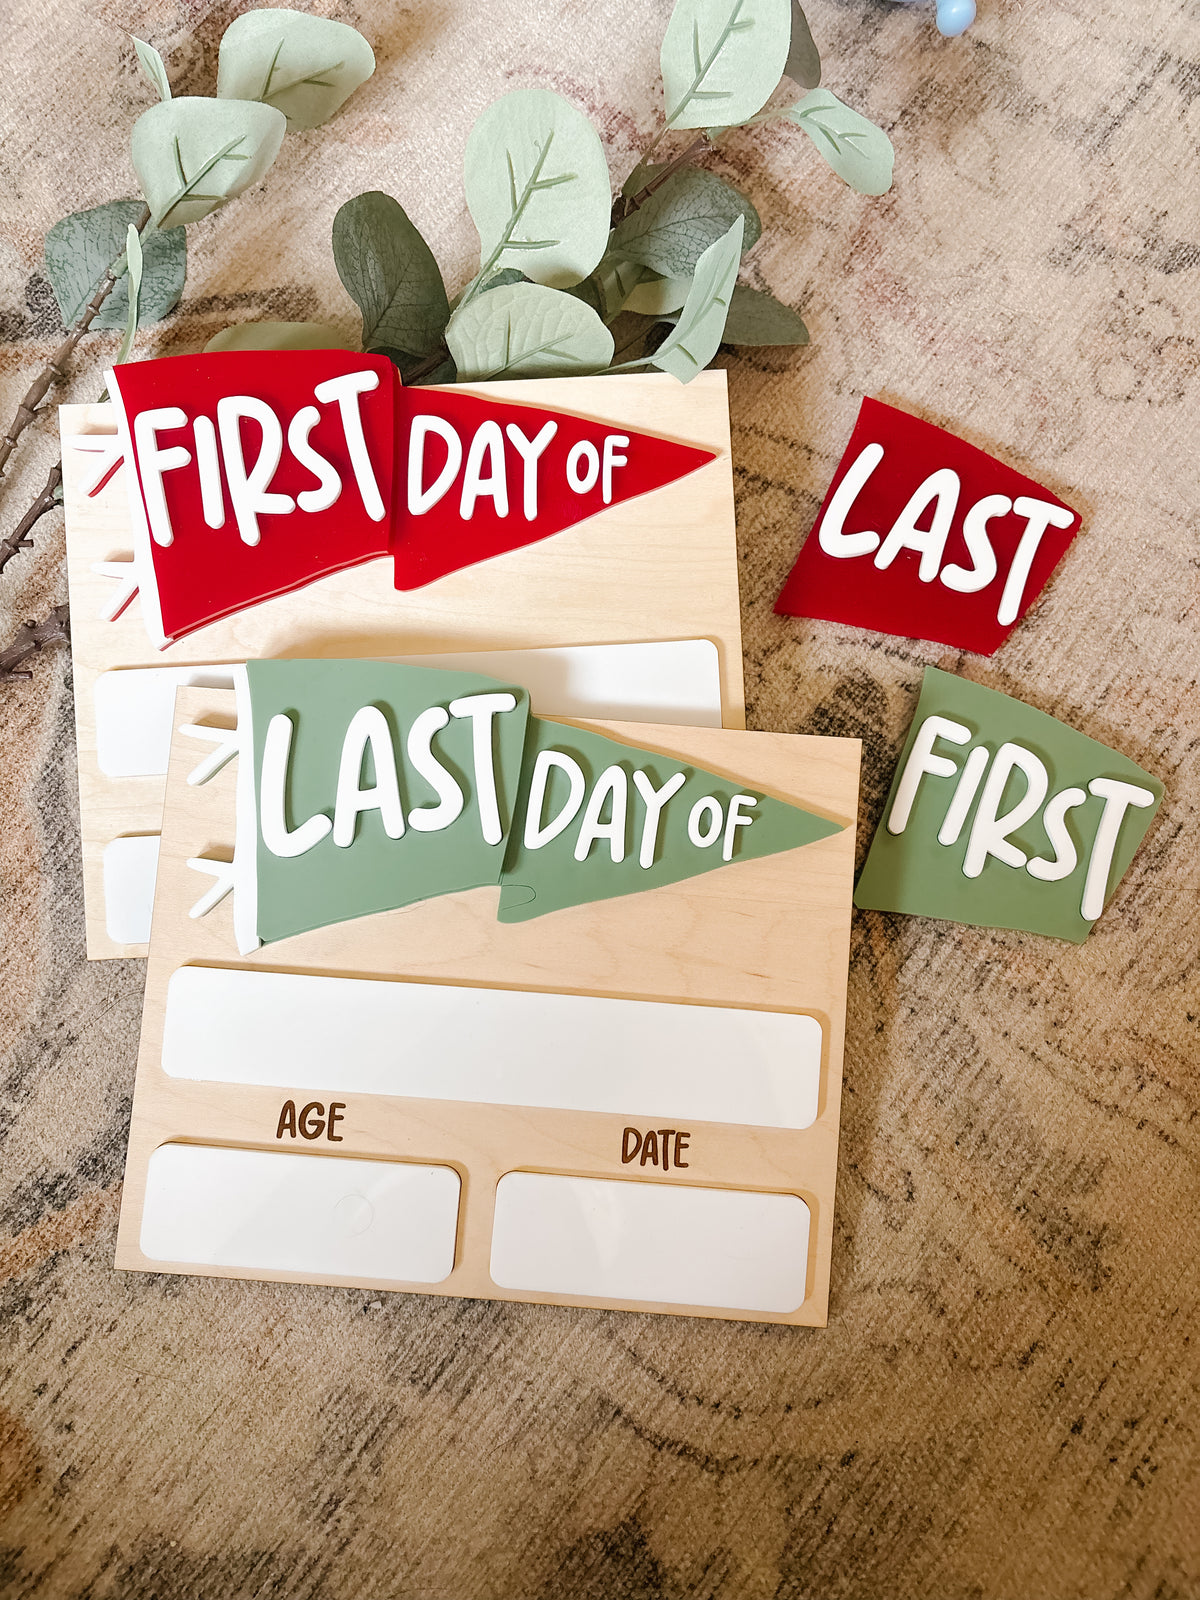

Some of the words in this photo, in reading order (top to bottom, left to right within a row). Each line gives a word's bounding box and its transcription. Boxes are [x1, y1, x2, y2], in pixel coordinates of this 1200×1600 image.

[133, 370, 386, 547] FIRST
[407, 414, 559, 521] DAY
[566, 435, 630, 504] OF
[819, 443, 1075, 627] LAST
[260, 693, 517, 858] LAST
[522, 750, 687, 869] DAY
[687, 794, 758, 862] OF
[888, 715, 1155, 922] FIRST
[276, 1099, 347, 1142] AGE
[621, 1127, 692, 1171] DATE
